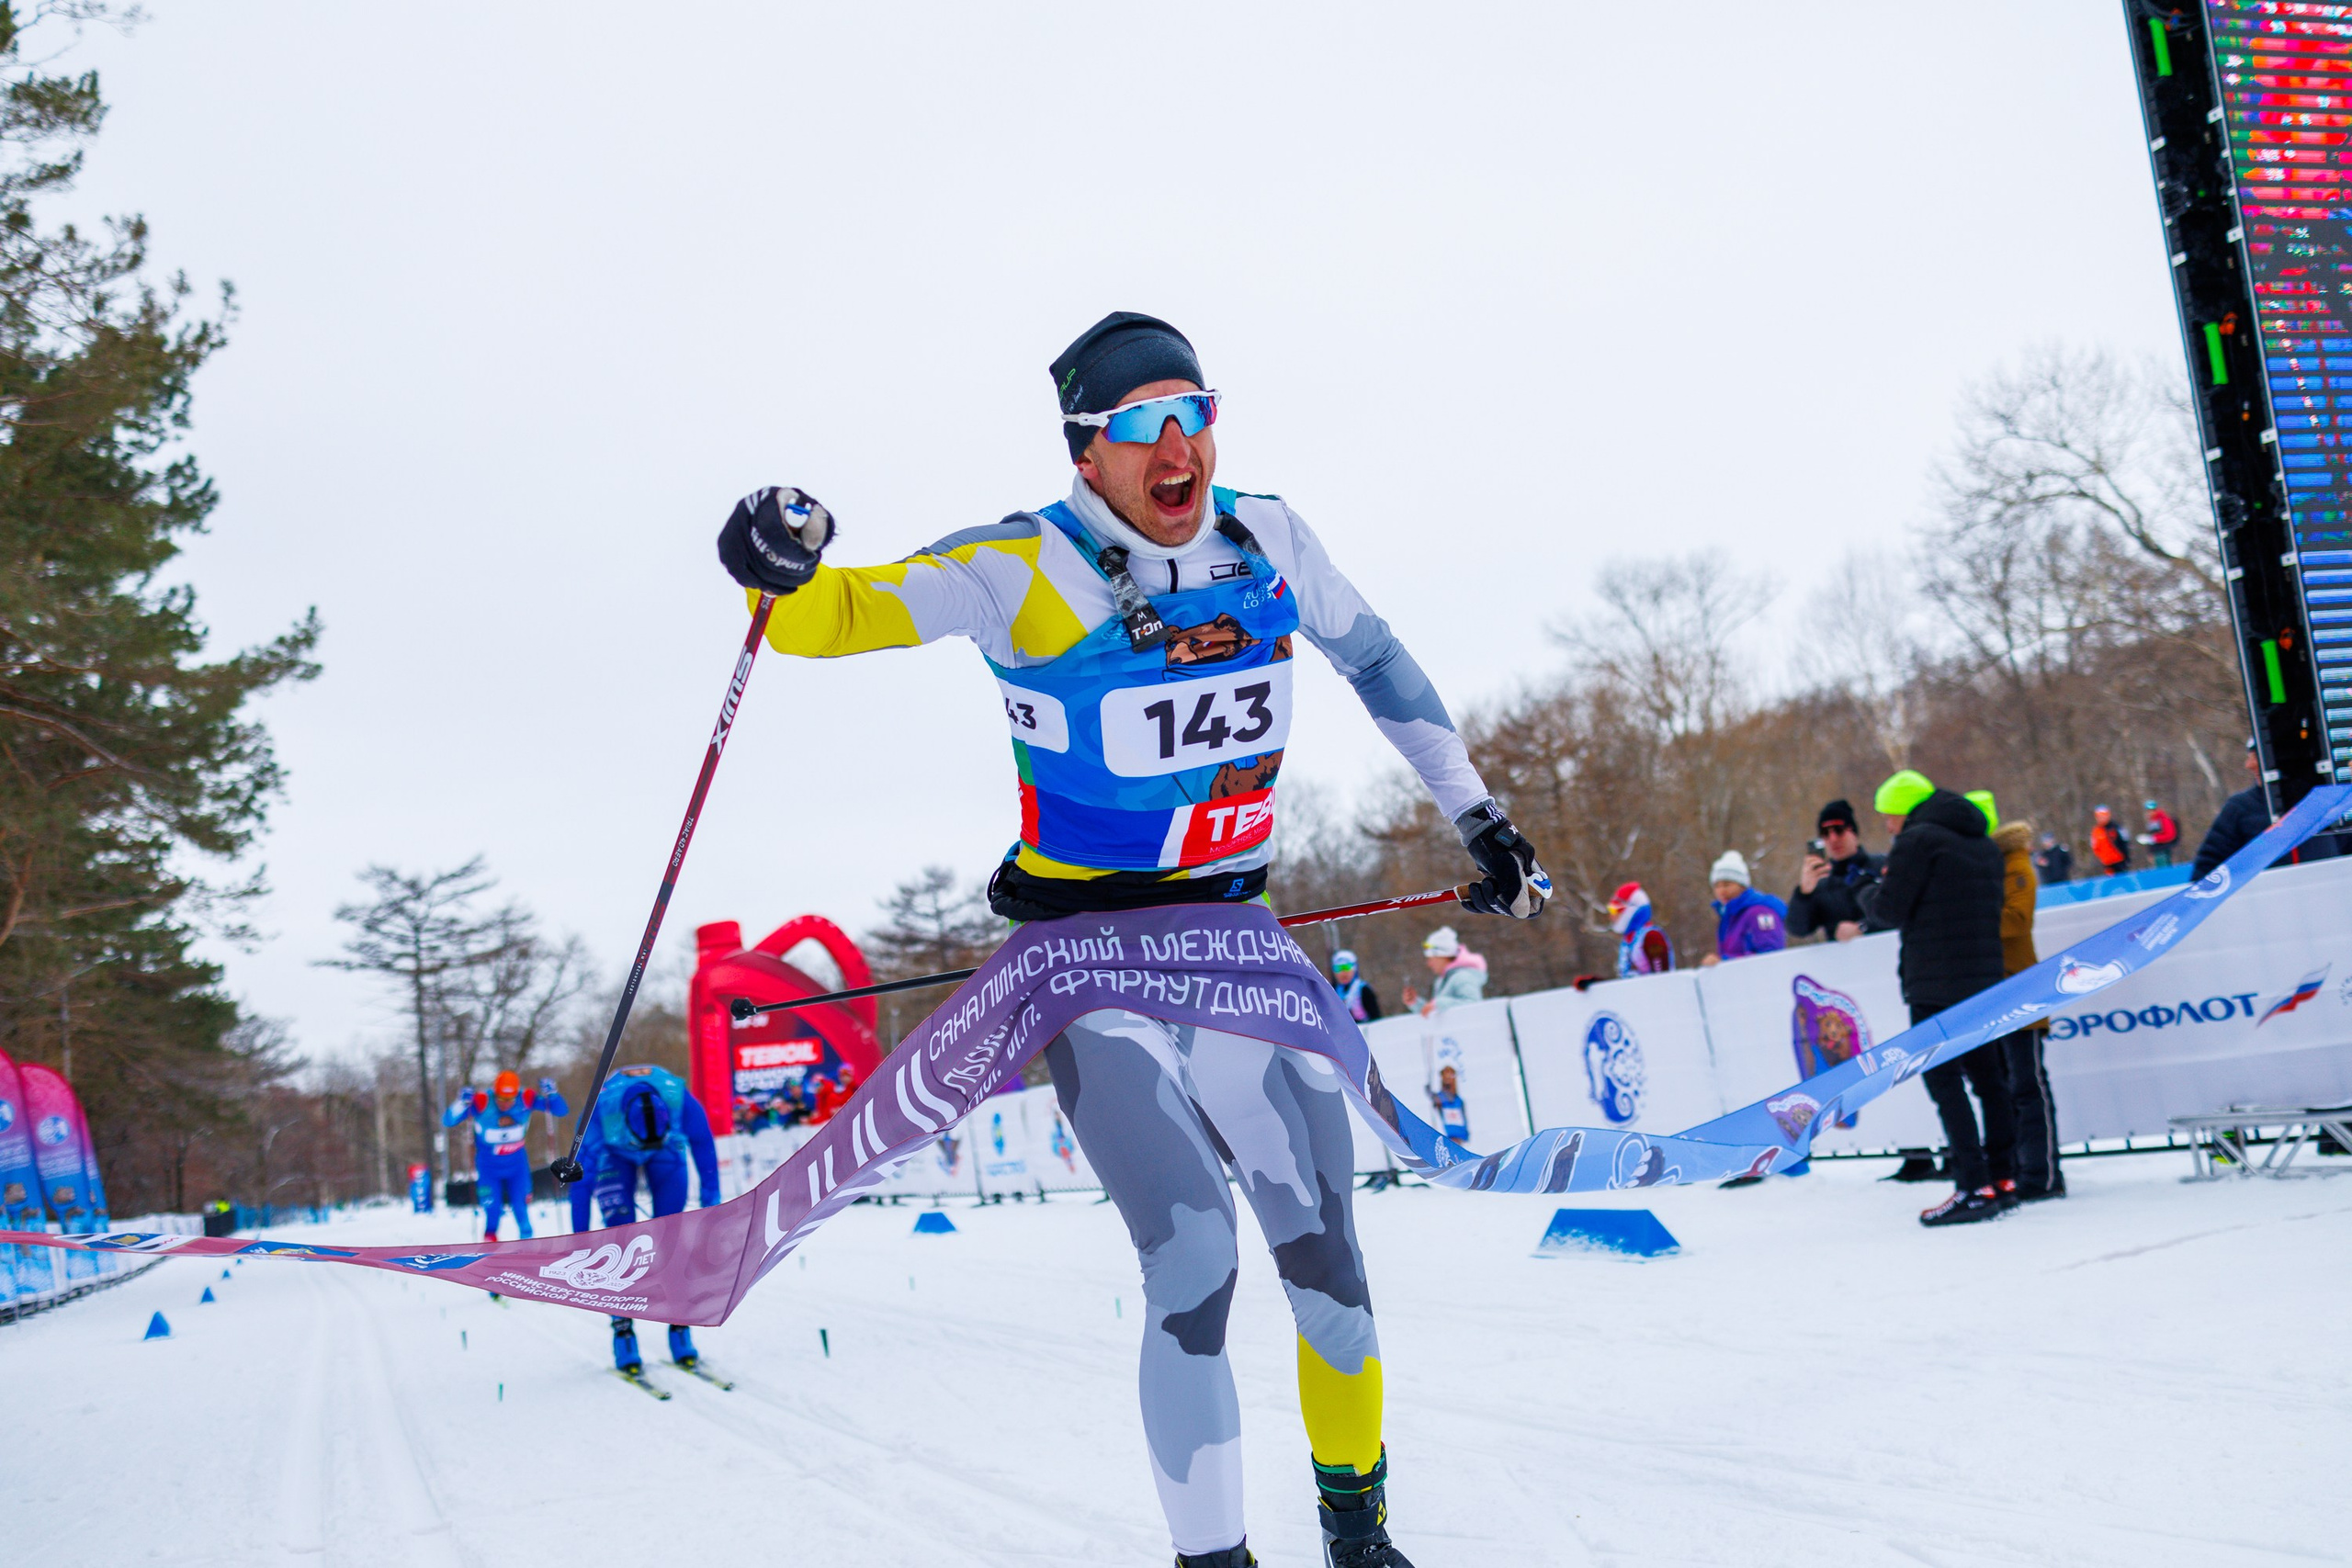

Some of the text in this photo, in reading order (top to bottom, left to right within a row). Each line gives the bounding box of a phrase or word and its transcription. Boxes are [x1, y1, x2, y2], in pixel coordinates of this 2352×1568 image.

[1144, 681, 1273, 759] 143
[683, 816, 695, 838] TRIAC
[1206, 790, 1274, 842] TEB
[929, 927, 1314, 1062] САХАЛИНСКИЙ МЕЖДУНА
[738, 1041, 818, 1067] TEBOIL
[633, 1251, 656, 1267] ЛЕТ
[484, 1276, 649, 1312] РОССИЙСКОЙ ФЕДЕРАЦИИ
[500, 1271, 649, 1303] МИНИСТЕРСТВО СПОРТА
